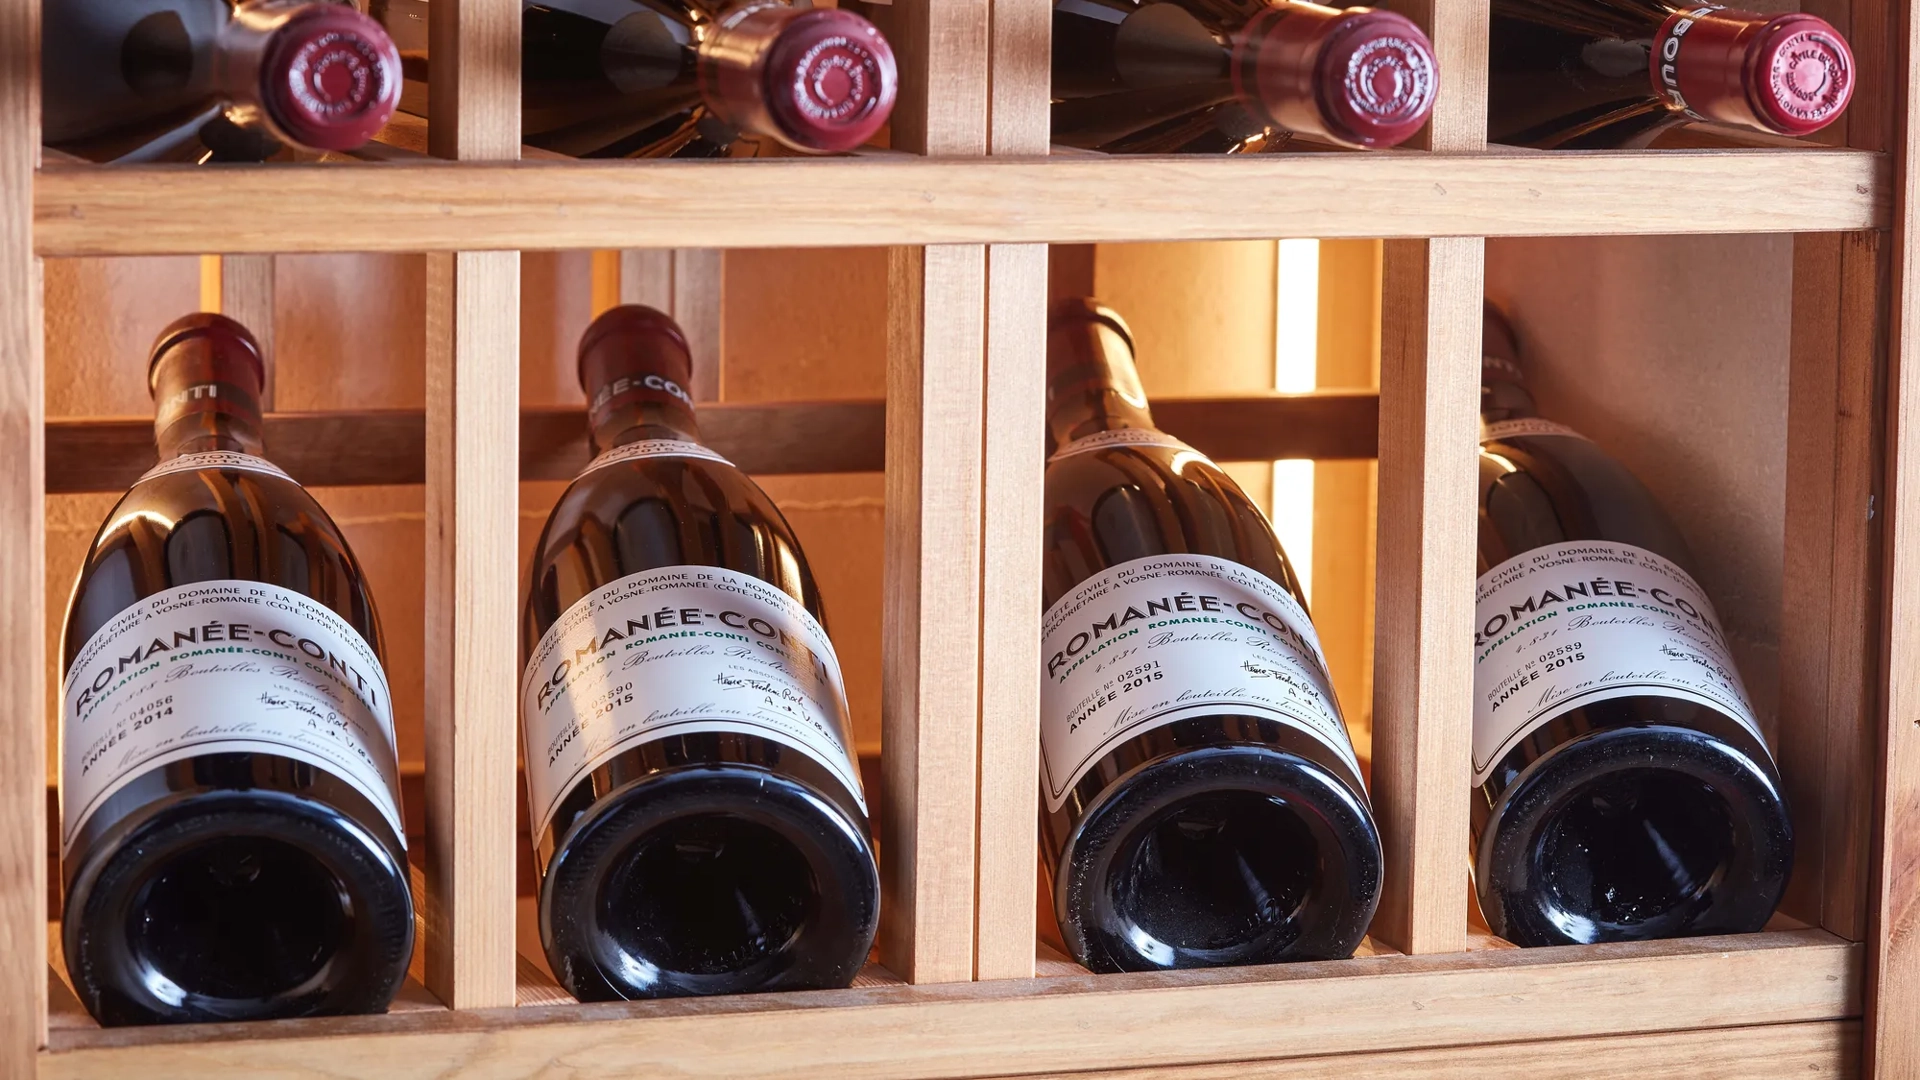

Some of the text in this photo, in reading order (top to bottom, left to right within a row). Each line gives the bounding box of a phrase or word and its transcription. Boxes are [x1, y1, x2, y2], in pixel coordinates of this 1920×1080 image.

[1076, 577, 1110, 600] CIVILE
[1117, 568, 1136, 580] DU
[1144, 561, 1203, 572] DOMAINE
[1210, 564, 1226, 572] DE
[1234, 569, 1248, 579] LA
[1491, 546, 1658, 584] CIVILE DU DOMAINE DE LA
[1539, 555, 1635, 570] VOSNE-ROMANÉE
[109, 607, 144, 632] CIVILE
[152, 597, 170, 609] DU
[178, 587, 240, 600] DOMAINE
[250, 588, 266, 597] DE
[276, 594, 290, 604] LA
[156, 596, 260, 616] VOSNE-ROMANÉE
[564, 600, 595, 626] CIVILE
[602, 588, 620, 600] DU
[628, 574, 688, 590] DOMAINE
[698, 573, 714, 581] DE
[722, 576, 738, 585] LA
[598, 604, 604, 612] A
[608, 582, 709, 606] VOSNE-ROMANÉE
[1046, 587, 1110, 638] PROPRIÉTAIRE
[1123, 569, 1222, 585] VOSNE-ROMANÉE
[1567, 614, 1654, 631] Bouteilles
[538, 606, 828, 710] ROMANÉE-CONTI
[622, 644, 714, 671] Bouteilles
[1060, 628, 1140, 684] APPELLATION
[1148, 616, 1267, 635] ROMANÉE-CONTI
[1147, 630, 1238, 648] Bouteilles
[1478, 611, 1558, 664] APPELLATION
[1567, 601, 1681, 620] ROMANÉE-CONTI
[76, 620, 377, 716] ROMANÉE-CONTI
[82, 662, 160, 723] APPELLATION
[170, 646, 298, 663] ROMANÉE-CONTI
[164, 661, 260, 682] Bouteilles
[544, 650, 616, 715] APPELLATION
[625, 630, 750, 650] ROMANÉE-CONTI
[1066, 689, 1100, 722] BOUTEILLE
[1117, 660, 1162, 683] 02591
[1488, 669, 1522, 702] BOUTEILLE
[1539, 642, 1582, 663] 02589
[1492, 652, 1586, 712] ANNÉE 2015
[1528, 685, 1572, 714] Mise
[1576, 679, 1594, 689] en
[1600, 670, 1669, 683] bouteille
[129, 696, 174, 721] 04056
[547, 718, 576, 756] BOUTEILLE
[591, 682, 634, 710] 02590
[618, 724, 637, 735] en
[642, 702, 716, 724] bouteille
[1070, 670, 1164, 734] ANNÉE 2015
[1102, 706, 1148, 736] Mise
[1152, 700, 1170, 711] en
[1176, 687, 1247, 703] bouteille
[82, 706, 174, 777] ANNÉE 2014
[180, 722, 257, 740] bouteille
[549, 694, 634, 768] ANNÉE 2015
